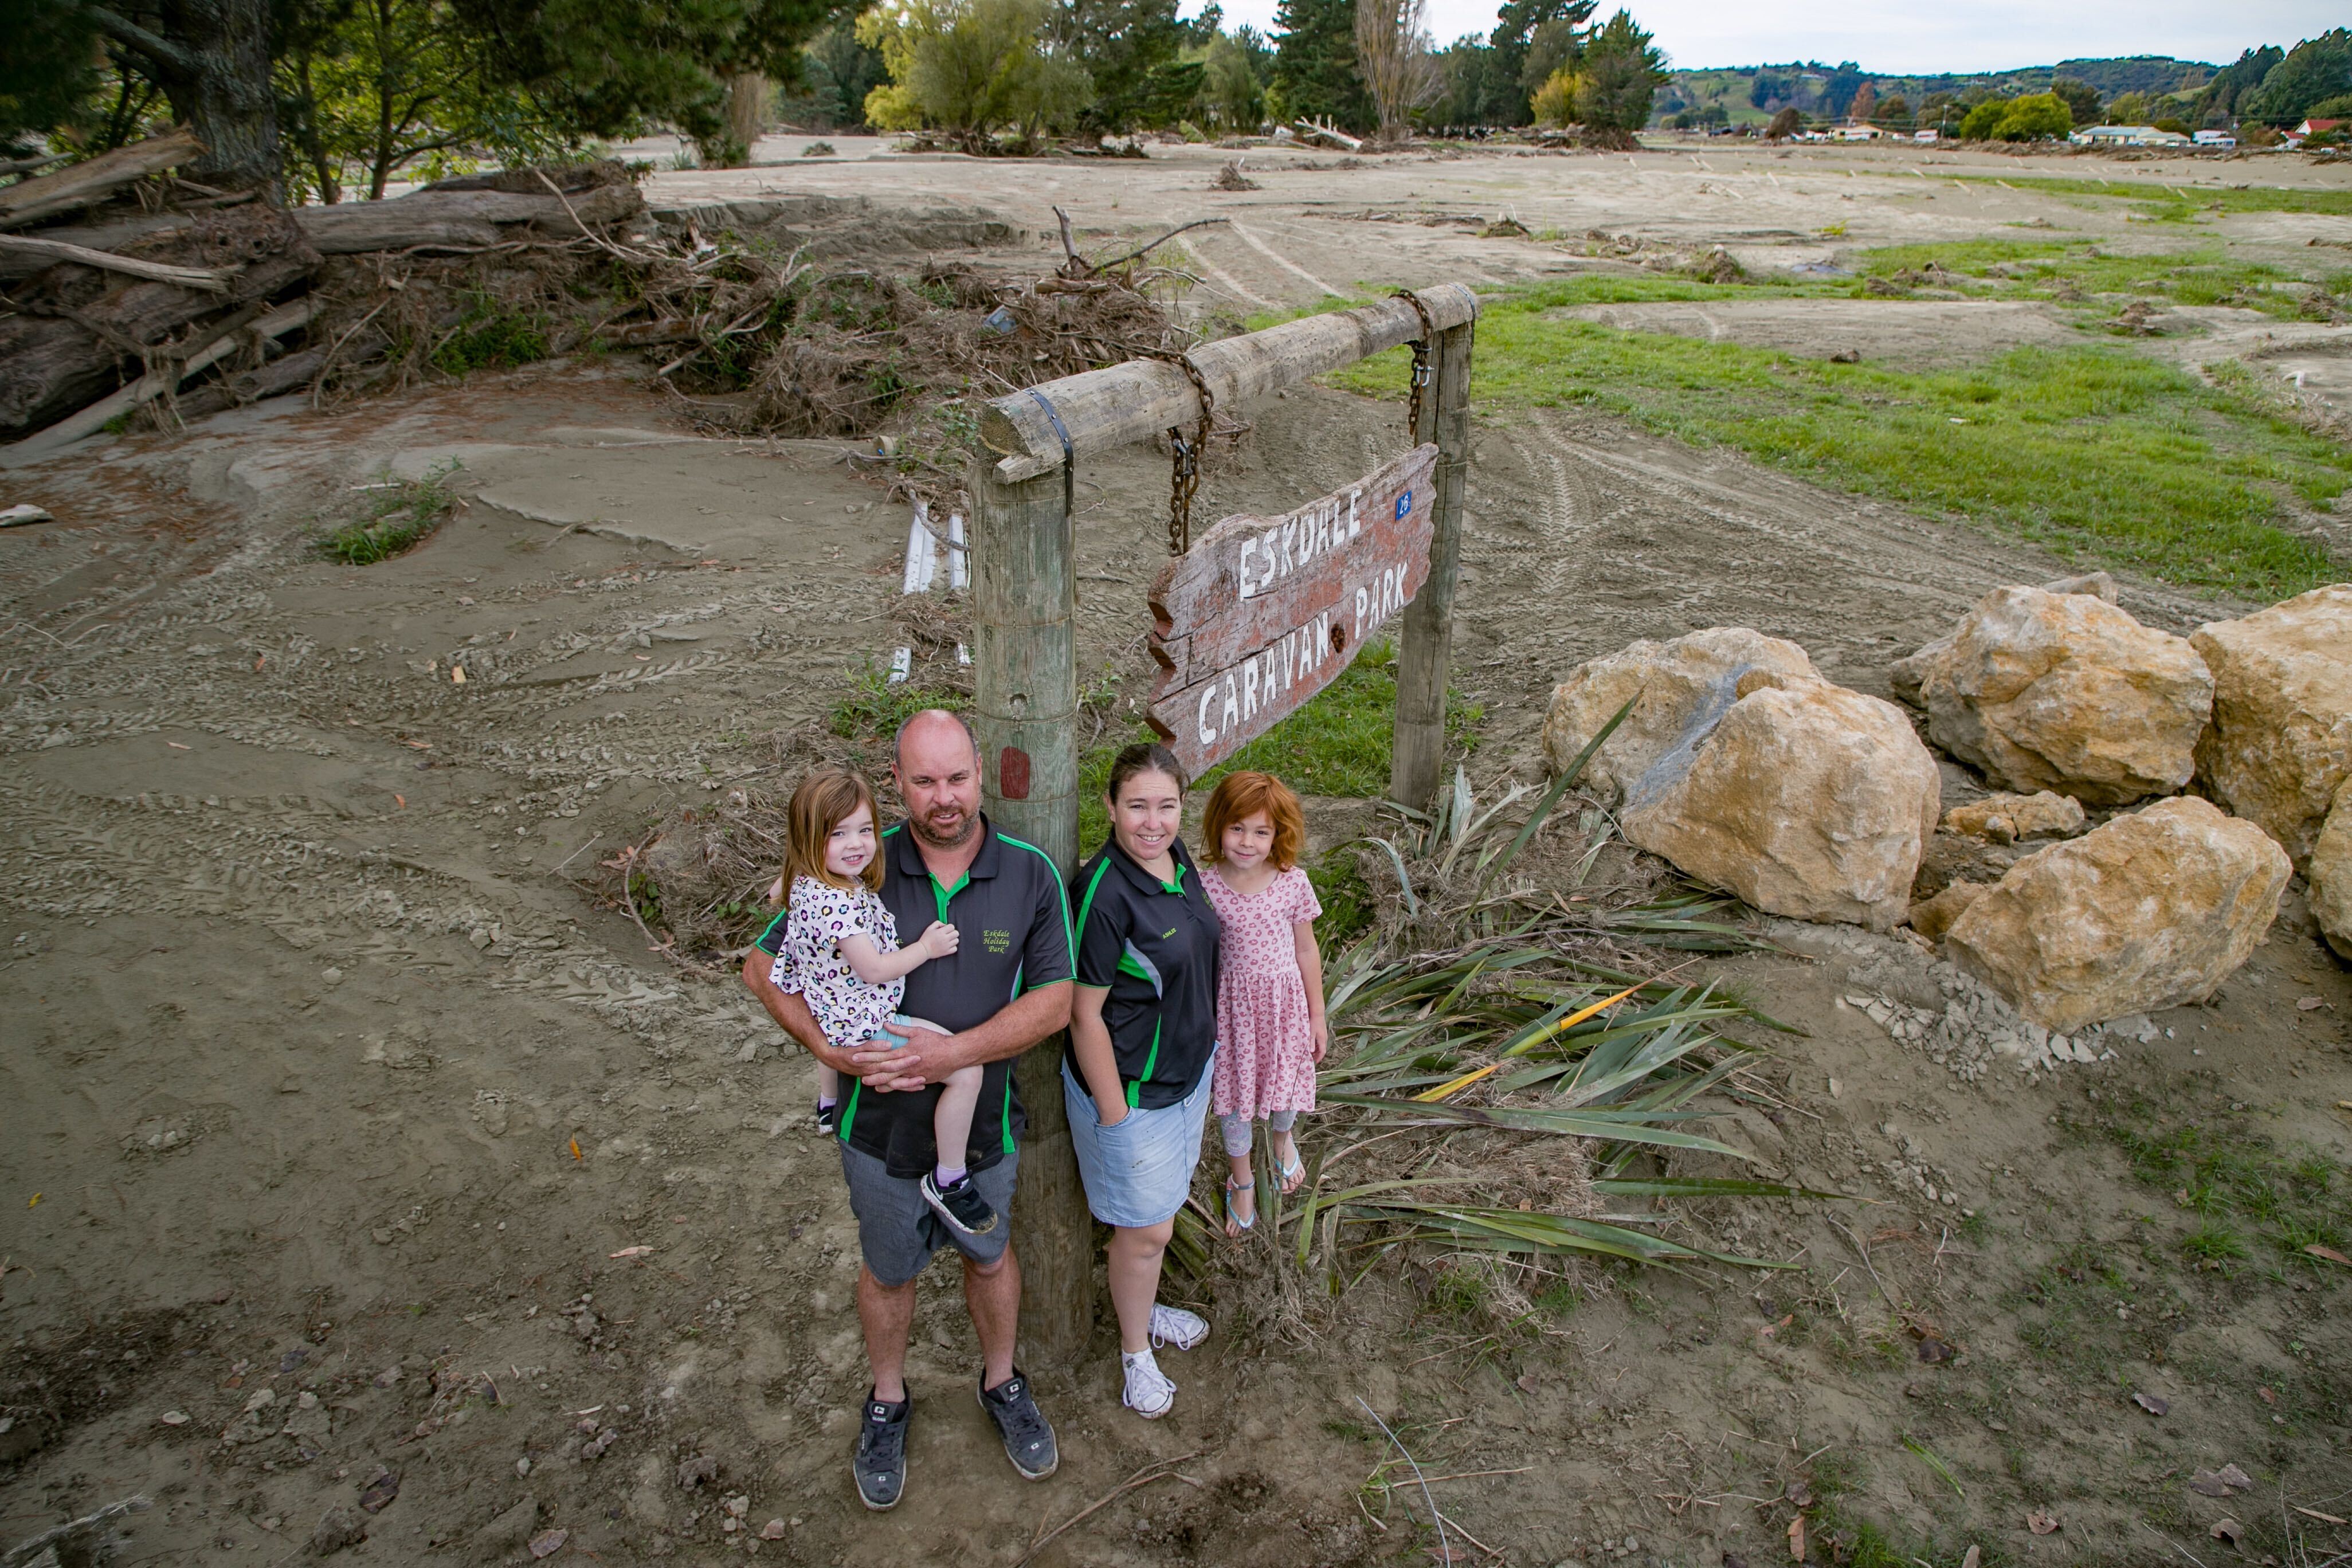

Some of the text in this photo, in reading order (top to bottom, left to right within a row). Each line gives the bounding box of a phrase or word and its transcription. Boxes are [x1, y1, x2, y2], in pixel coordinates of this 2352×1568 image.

[1400, 495, 1409, 515] 26
[1240, 489, 1362, 602] ESKDALE
[1199, 560, 1408, 744] CARAVAN PARK
[983, 930, 1010, 938] Eskdale
[983, 937, 1010, 947] Holiday
[989, 946, 1005, 954] Park
